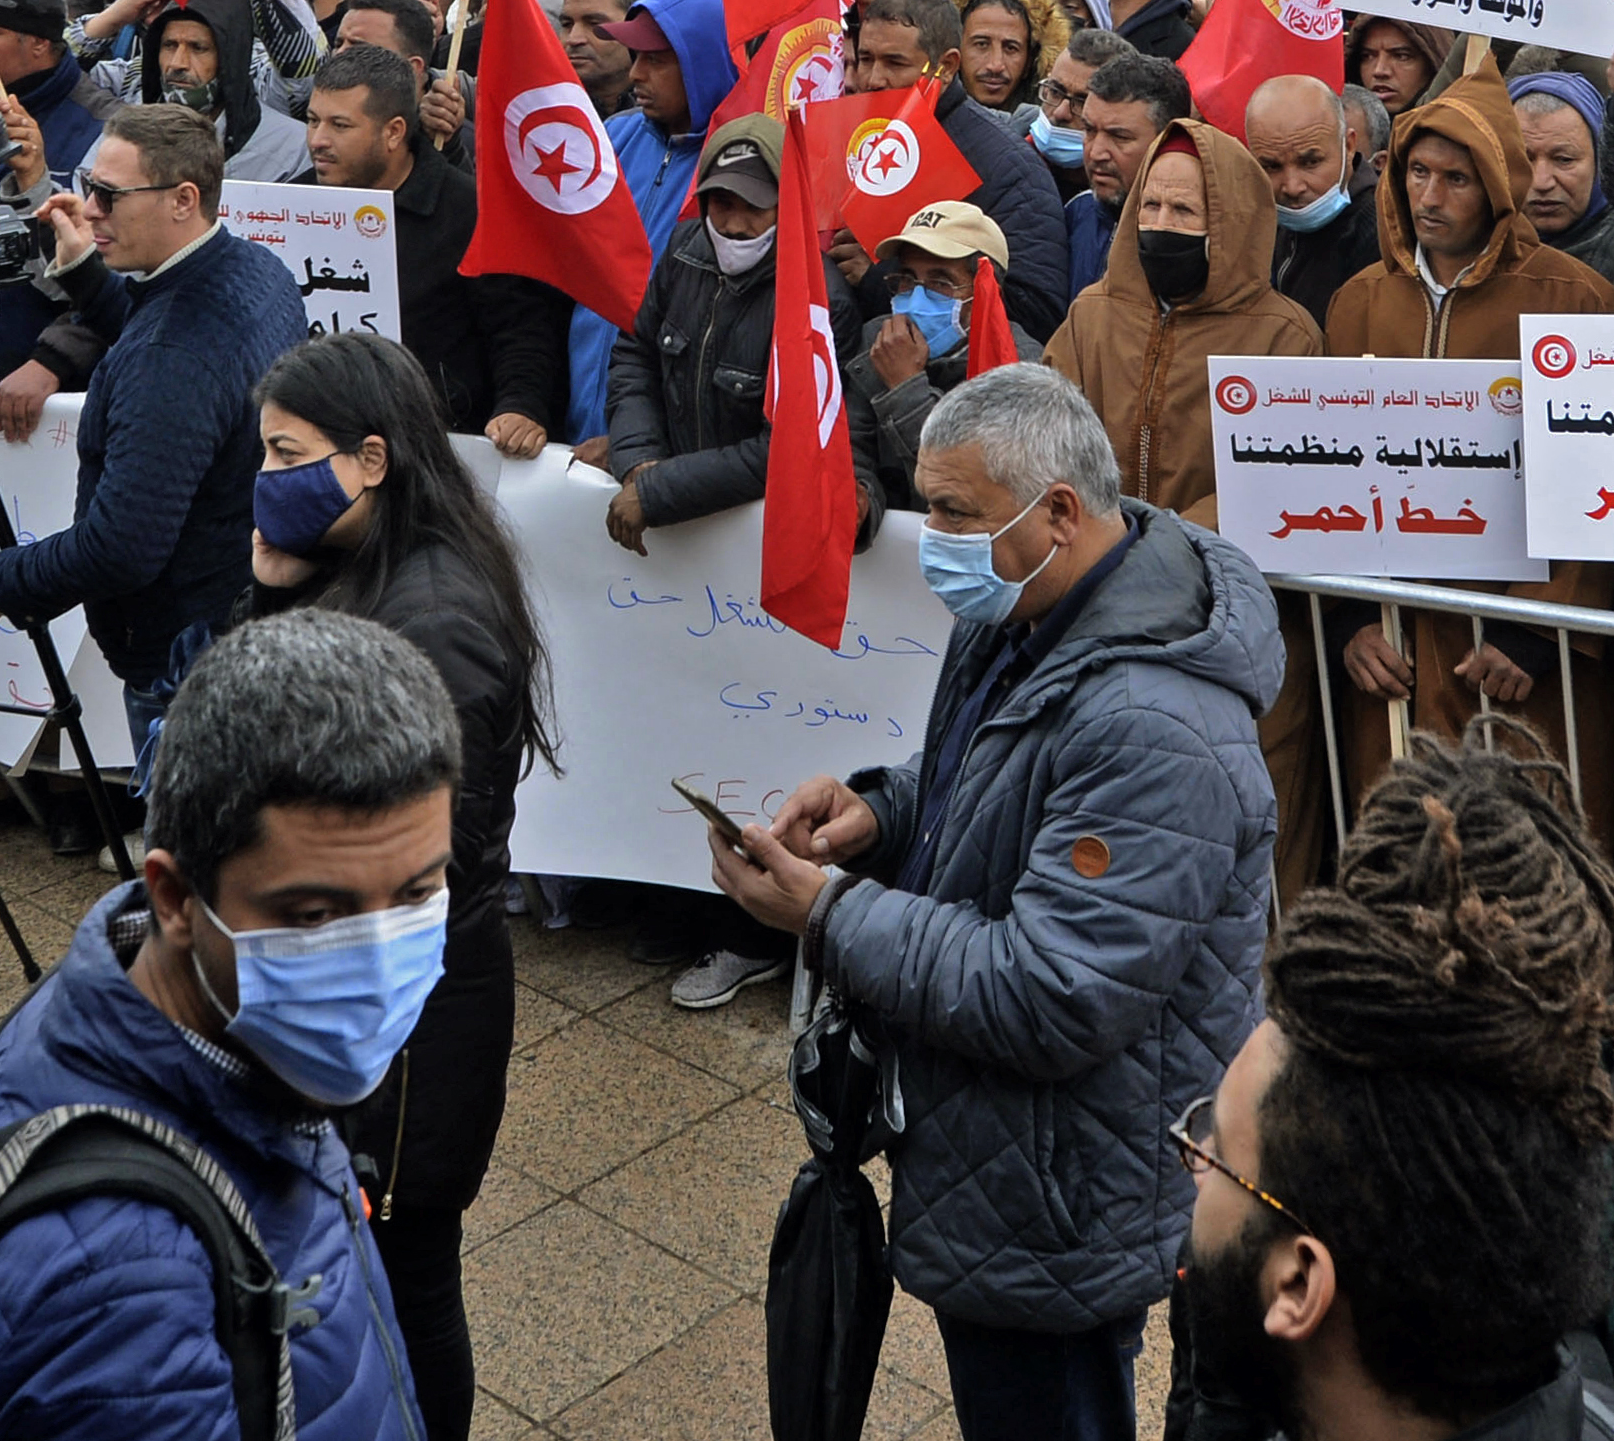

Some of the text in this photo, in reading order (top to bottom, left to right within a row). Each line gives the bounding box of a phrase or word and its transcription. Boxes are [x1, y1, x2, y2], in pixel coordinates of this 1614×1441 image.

[911, 211, 946, 229] CAT
[298, 256, 371, 297] شغل
[1230, 432, 1523, 480] إستقلالية منظمتنا
[1268, 484, 1384, 539] أحمر
[607, 576, 940, 660] حق حق
